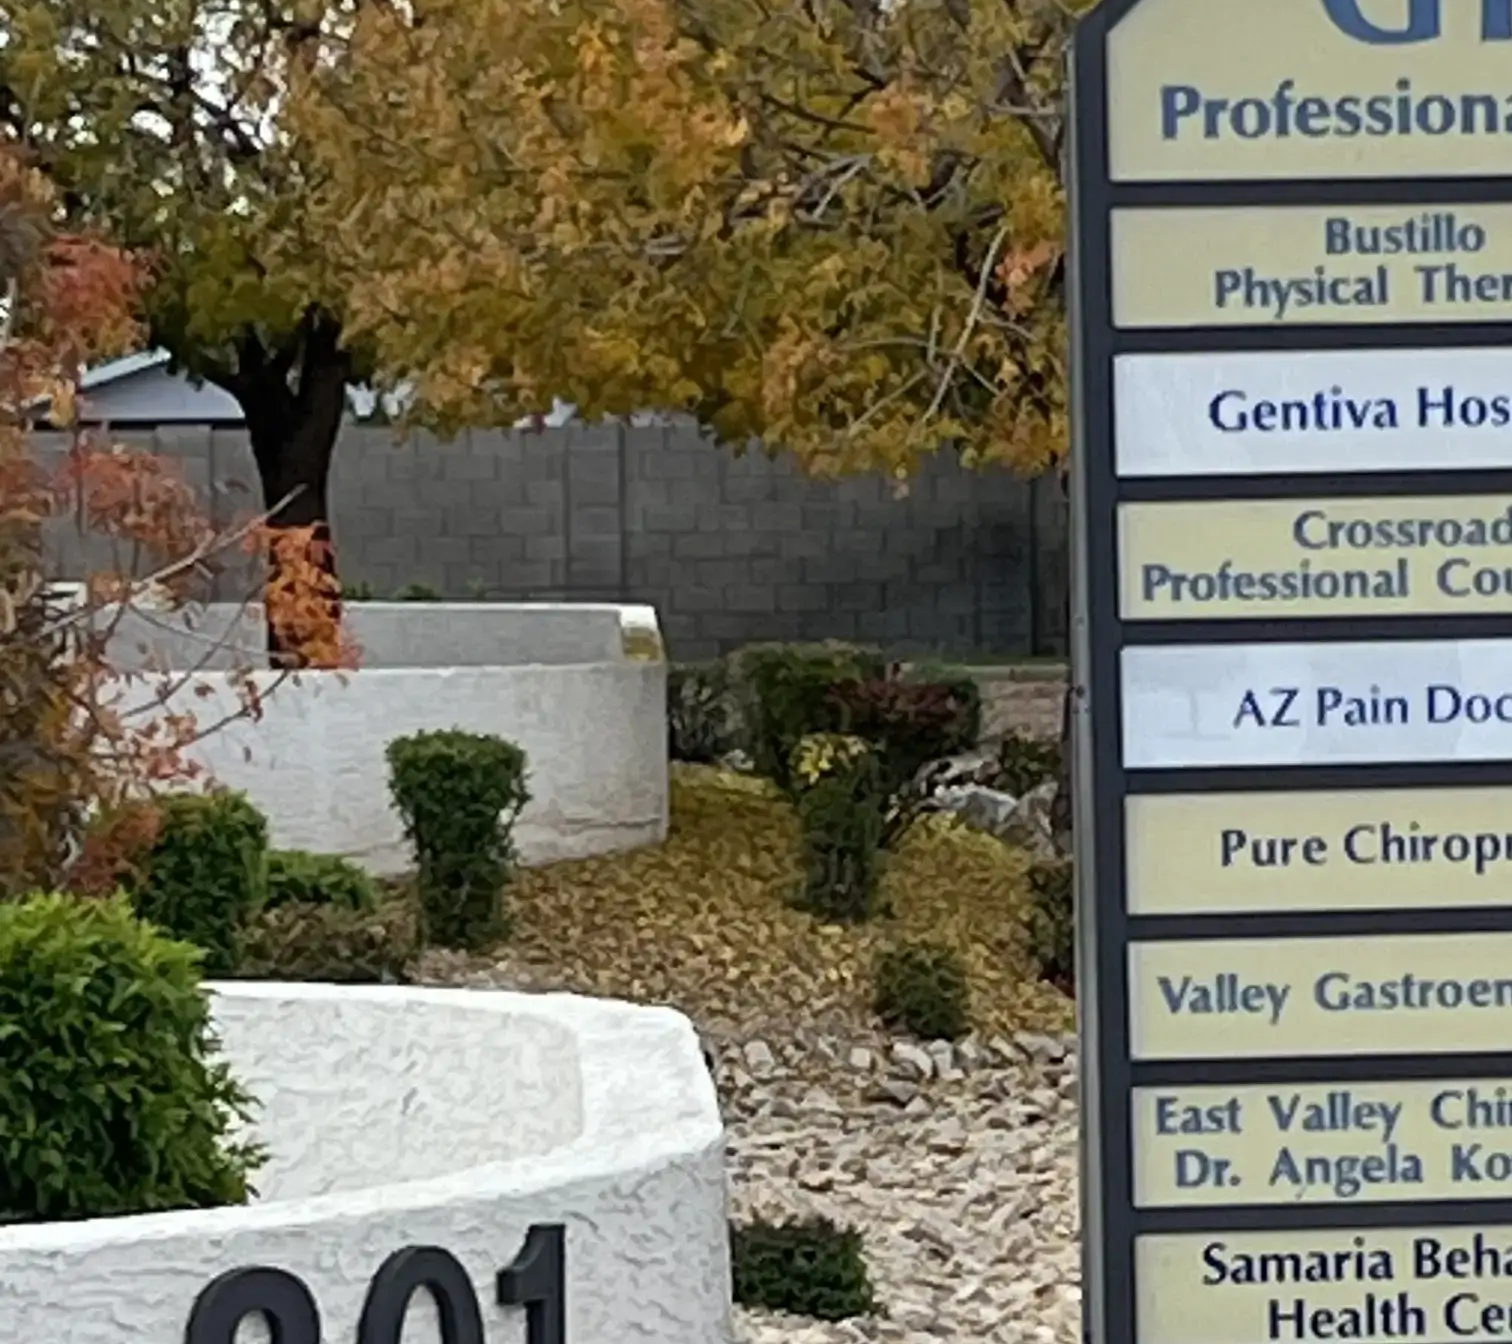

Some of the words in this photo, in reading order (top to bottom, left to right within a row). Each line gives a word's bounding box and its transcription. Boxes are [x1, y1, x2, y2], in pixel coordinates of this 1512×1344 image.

[1325, 212, 1486, 255] Bustillo
[1214, 264, 1389, 320] Physical
[1208, 386, 1399, 432] Gentiva
[1141, 557, 1409, 602] Professional
[1233, 688, 1300, 727] AZ
[1316, 685, 1409, 727] Pain
[1221, 829, 1328, 867] Pure
[1156, 972, 1291, 1025] Valley
[1155, 1096, 1242, 1136] East
[1266, 1090, 1403, 1144] Valley
[1175, 1149, 1242, 1189] Dr.
[1268, 1142, 1424, 1198] Angela
[1202, 1236, 1394, 1286] Samaria
[1269, 1292, 1426, 1340] Health
